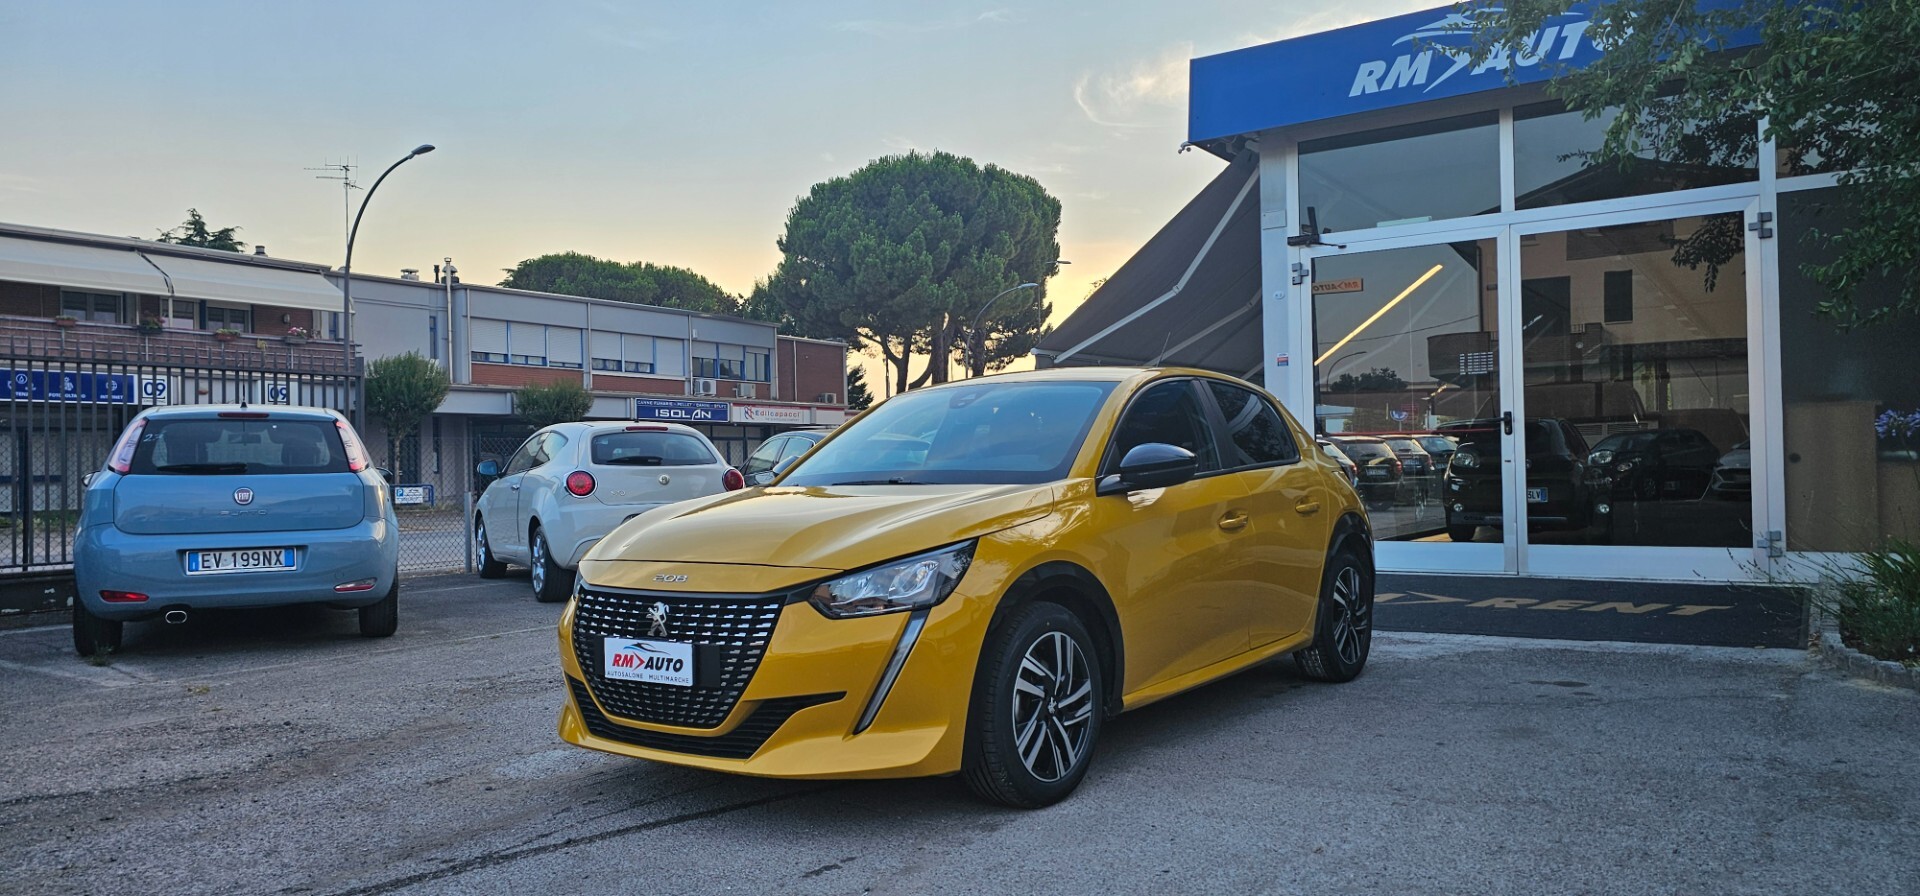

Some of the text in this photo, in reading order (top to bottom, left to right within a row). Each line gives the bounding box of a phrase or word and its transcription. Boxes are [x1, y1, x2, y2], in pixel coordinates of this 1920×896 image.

[1348, 50, 1432, 97] RM
[144, 381, 167, 397] 09
[655, 408, 711, 421] ISOLAN
[238, 492, 250, 500] FIAT
[201, 550, 284, 569] EV 199NX
[652, 573, 688, 582] 208
[1465, 597, 1738, 616] RENT
[612, 653, 684, 673] RM AUTO
[607, 670, 690, 684] AUTOSALONE MULTIMARCHE
